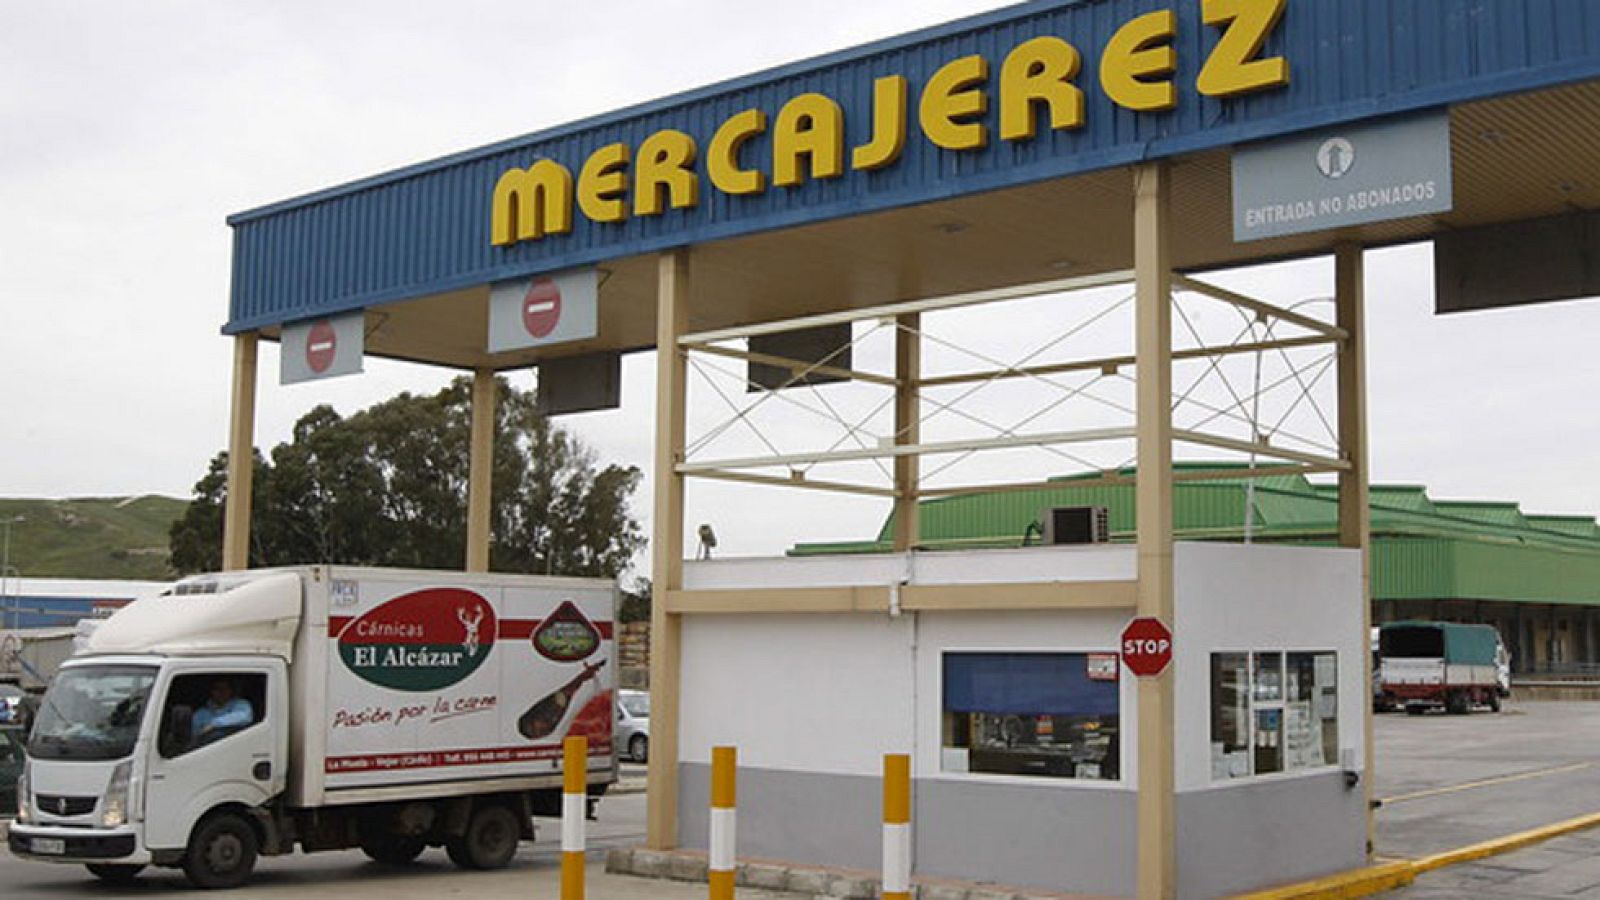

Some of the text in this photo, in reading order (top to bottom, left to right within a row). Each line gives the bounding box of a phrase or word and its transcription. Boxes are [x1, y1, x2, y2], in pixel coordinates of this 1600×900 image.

[491, 0, 1289, 246] MERCAJEREZ
[1245, 181, 1436, 227] ENTRADA NO ABONADOS
[356, 621, 424, 636] Cárnicas
[354, 646, 463, 666] El Alcázar
[1124, 639, 1170, 655] STOP
[333, 695, 497, 728] Pasión por la carne
